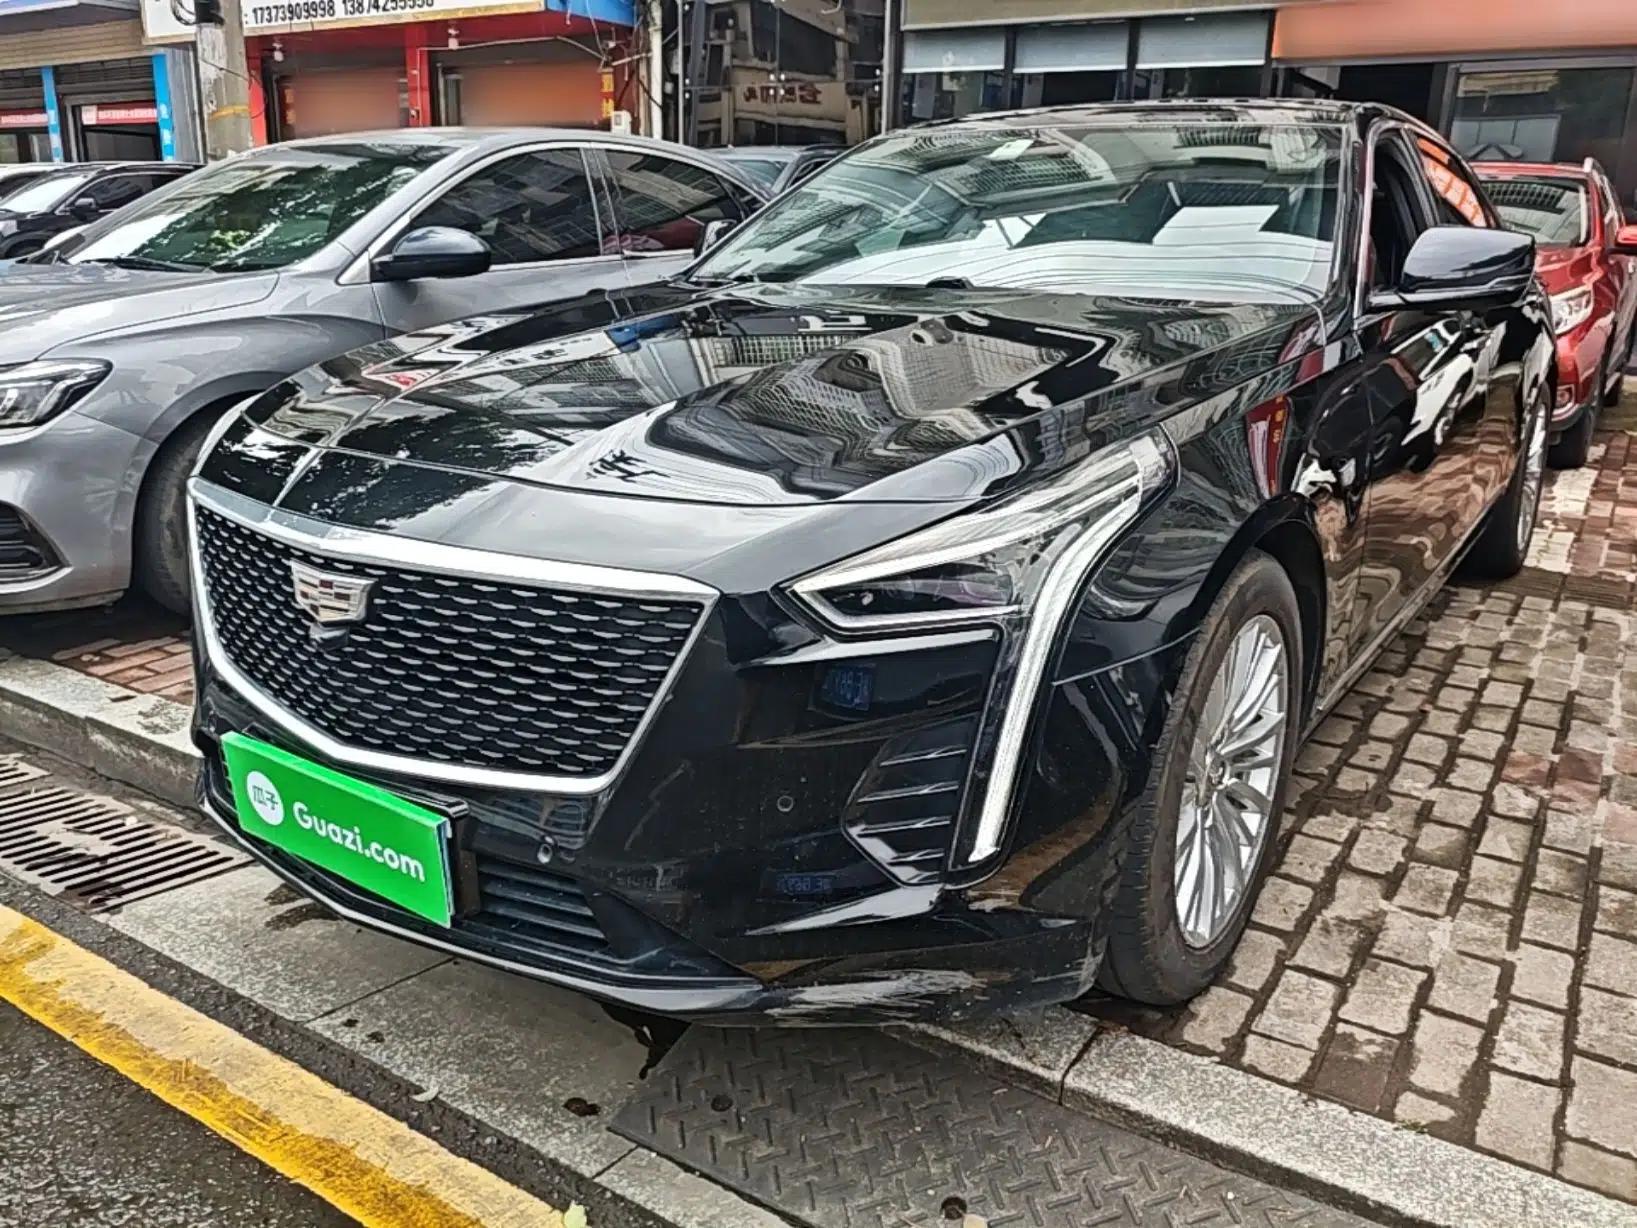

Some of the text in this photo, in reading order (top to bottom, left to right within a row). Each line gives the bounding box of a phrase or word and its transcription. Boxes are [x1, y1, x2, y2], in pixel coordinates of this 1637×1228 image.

[252, 0, 336, 24] 17373909998
[252, 785, 279, 811] 瓜子
[293, 802, 426, 883] Guazi.com
